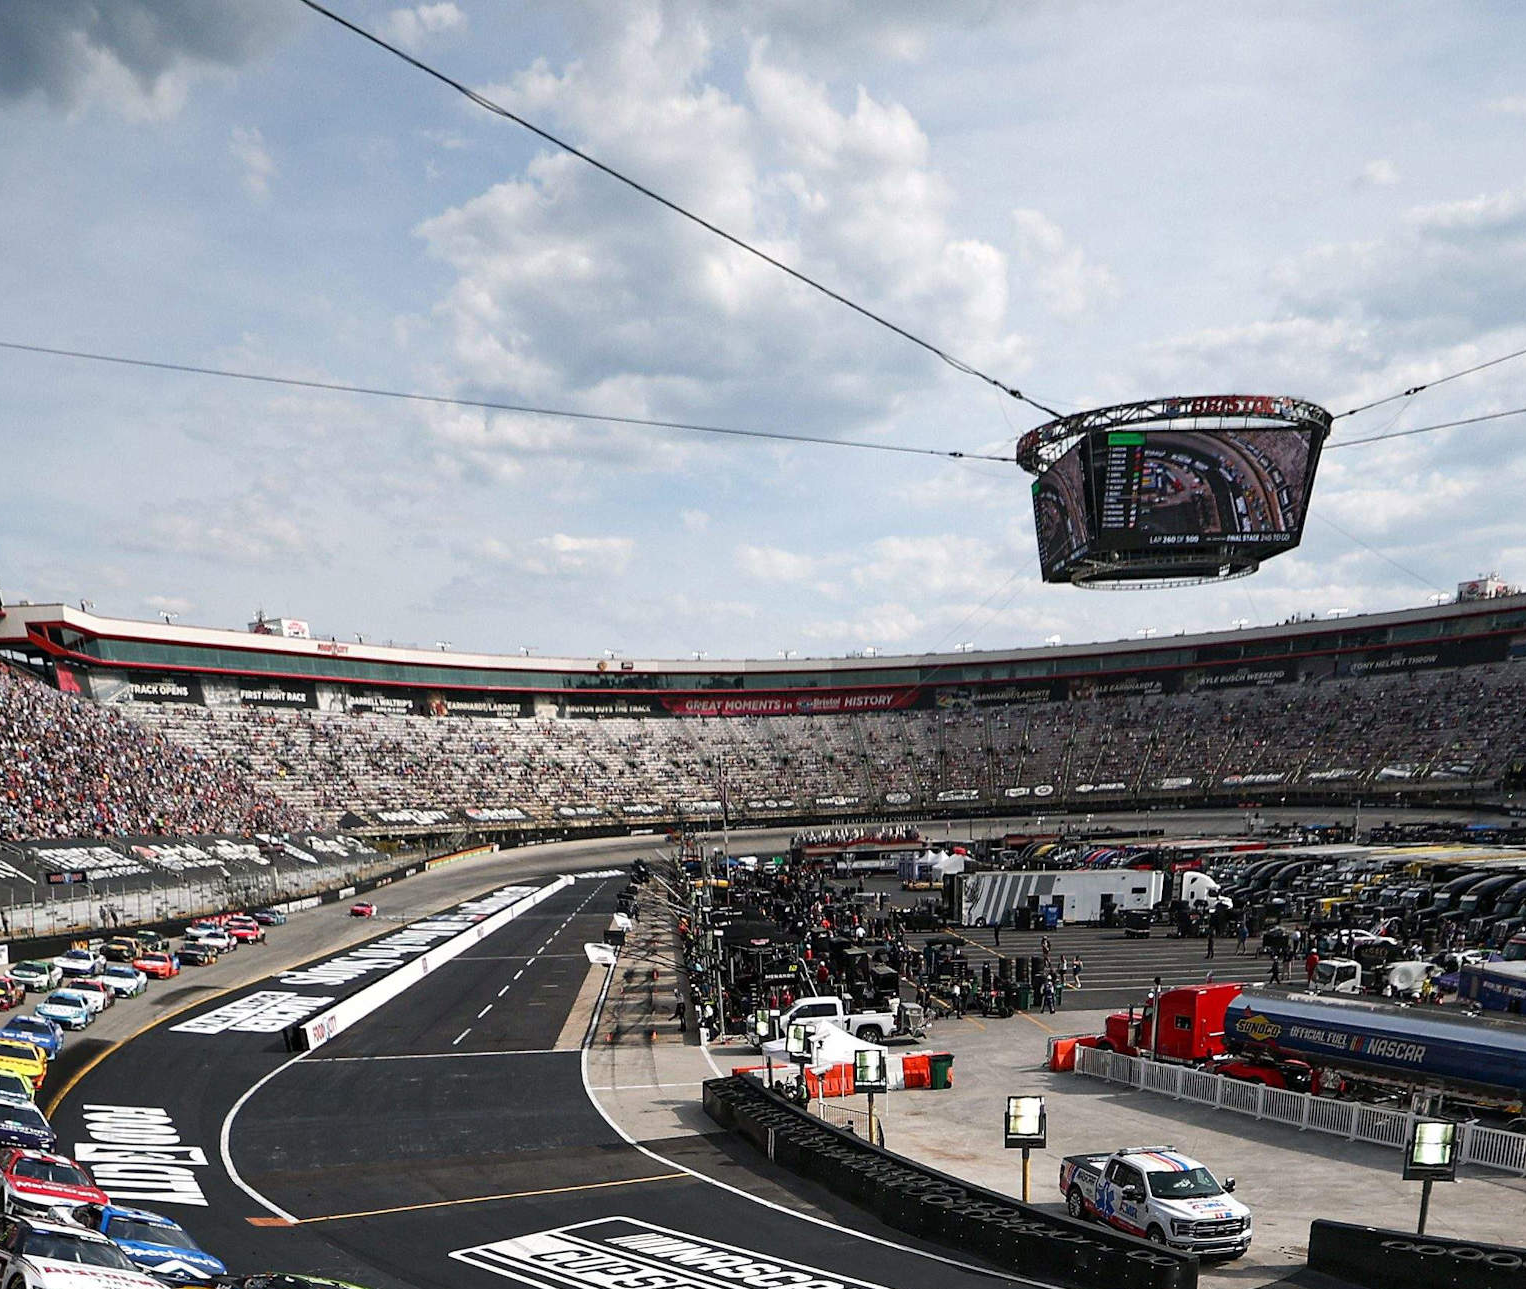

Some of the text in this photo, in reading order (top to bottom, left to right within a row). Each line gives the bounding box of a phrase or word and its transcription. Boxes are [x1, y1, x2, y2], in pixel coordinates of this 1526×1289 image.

[129, 684, 189, 697] TRACK OPENS
[240, 689, 307, 703] FIRST NIGHT RACE
[685, 699, 722, 711] GREAT
[725, 699, 781, 711] MOMENTS
[813, 696, 841, 709] Bristol
[844, 695, 893, 707] HISTORY
[1235, 1015, 1283, 1040] SUNOCO
[1290, 1026, 1426, 1064] OFFICIAL FUEL NASCAR
[16, 1180, 100, 1200] Motorcraft
[120, 1246, 223, 1270] Spectrum
[533, 1248, 637, 1278] CUP
